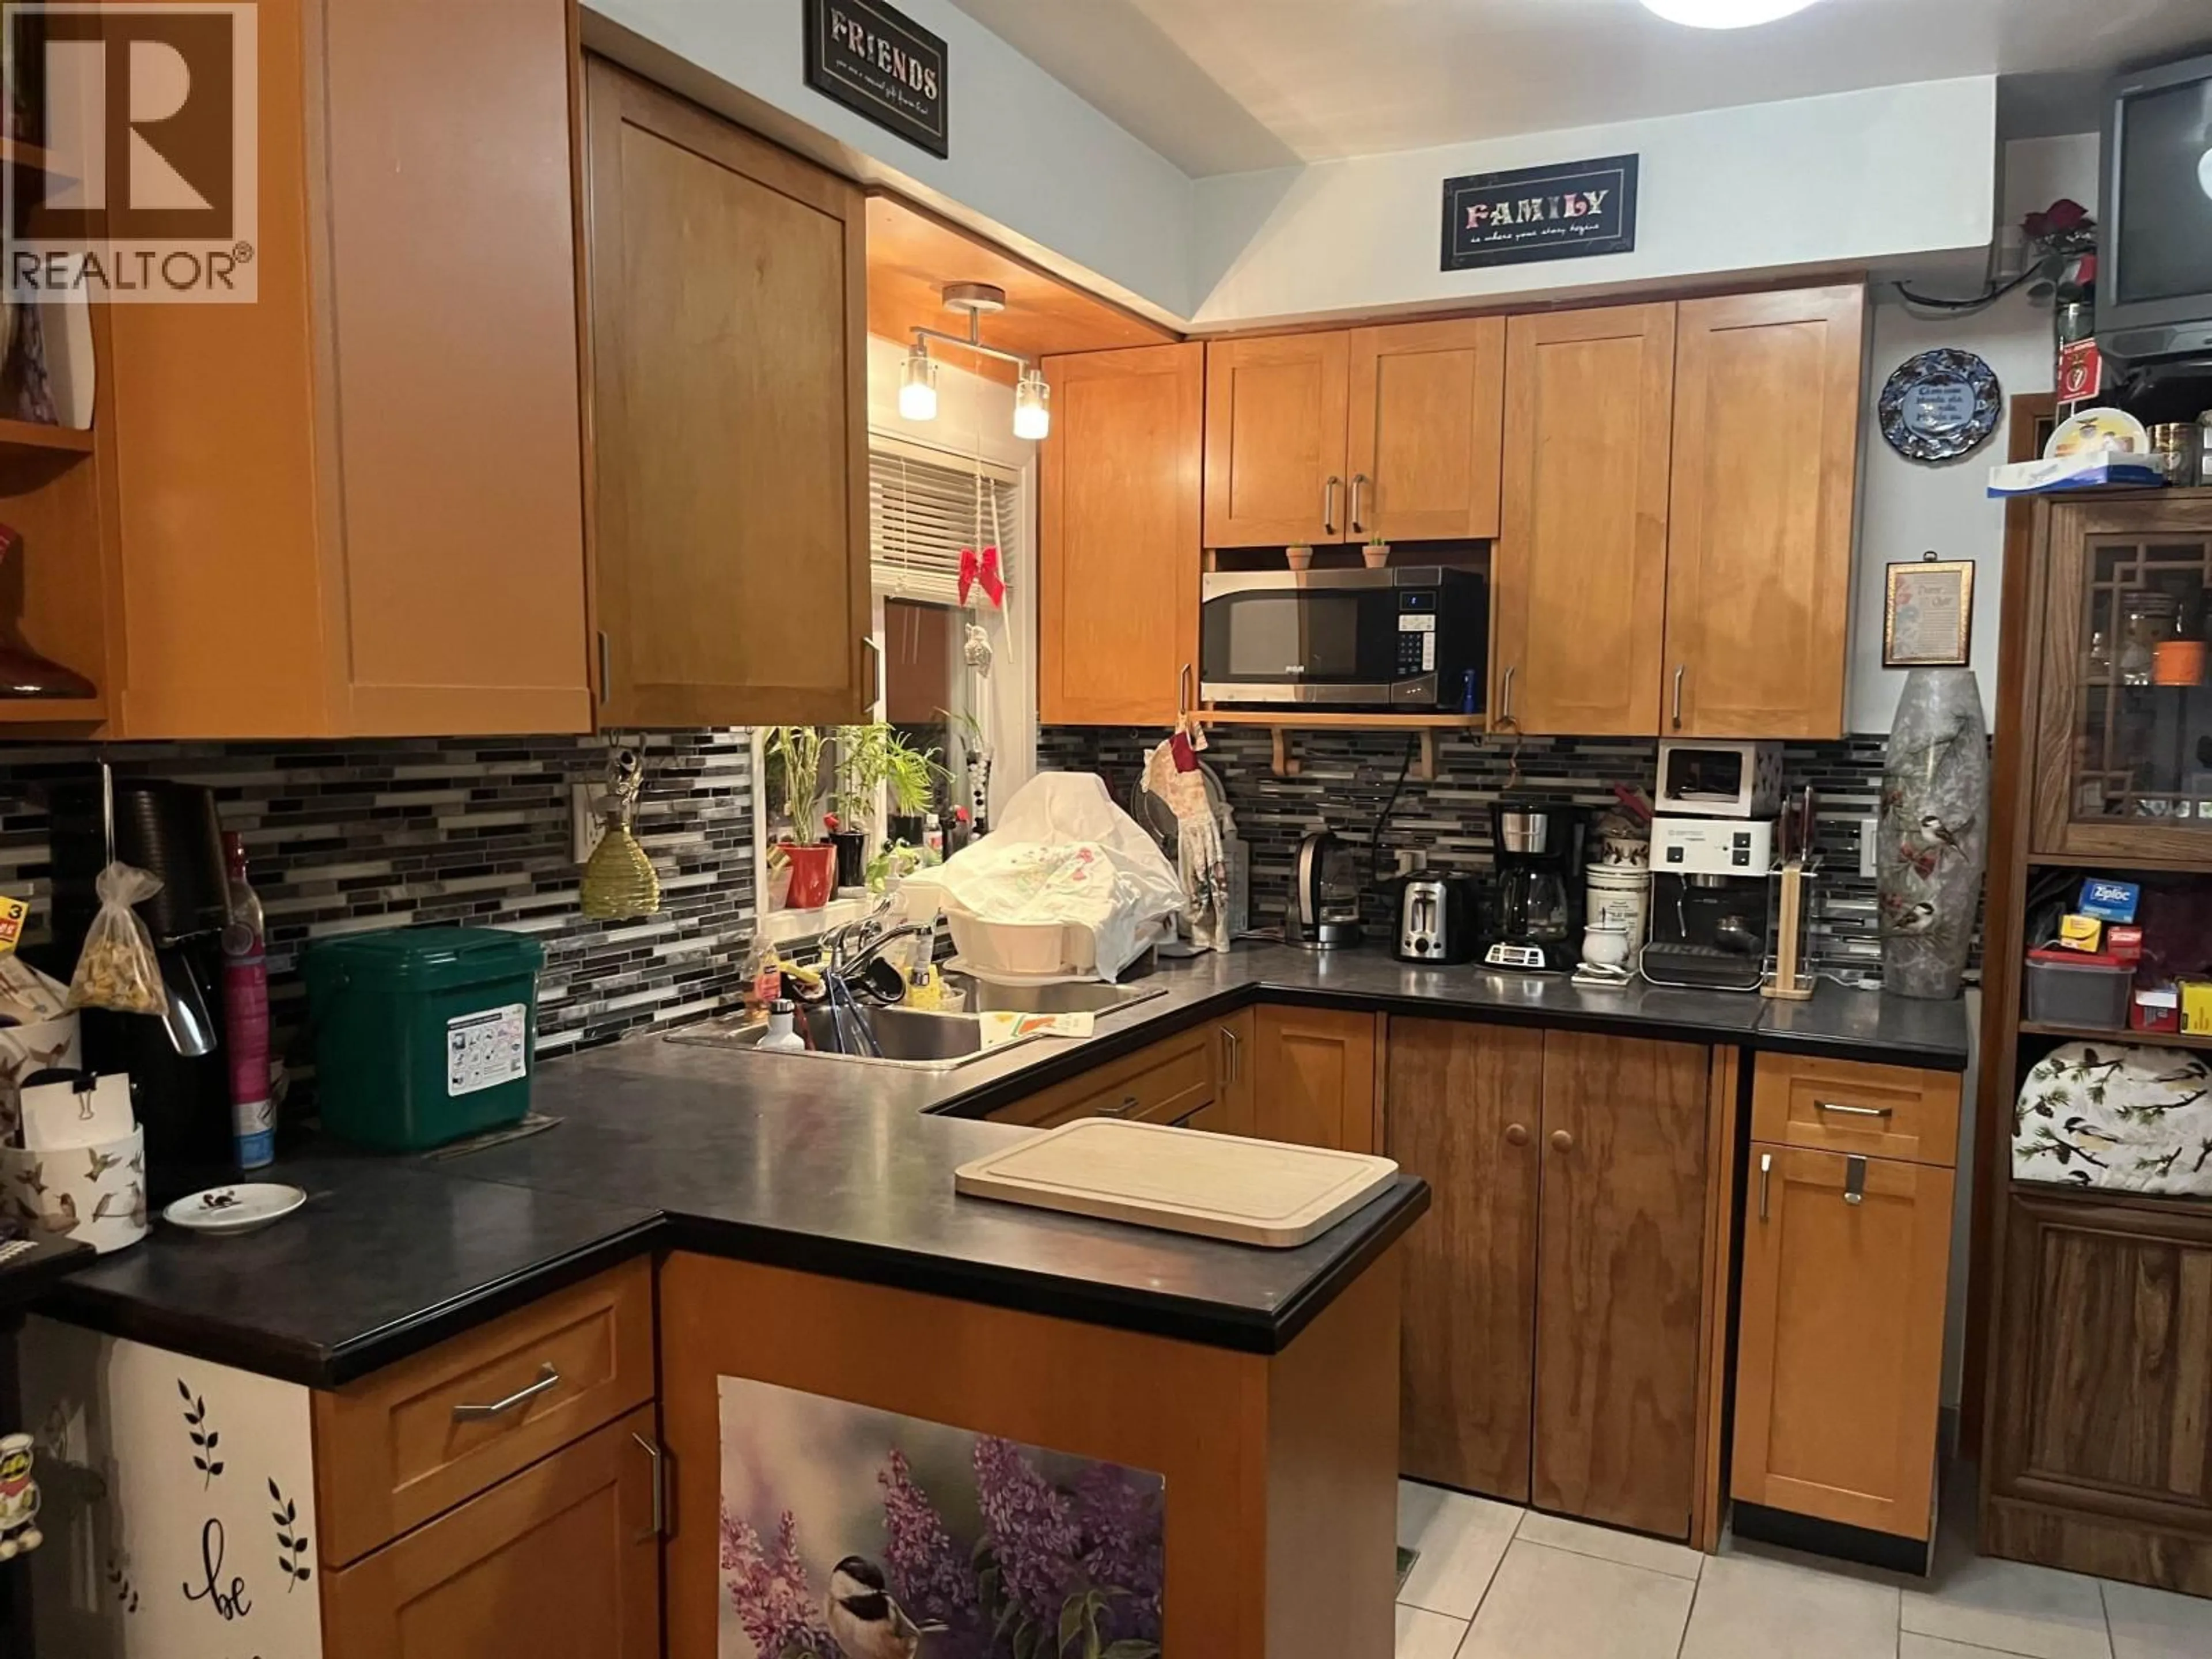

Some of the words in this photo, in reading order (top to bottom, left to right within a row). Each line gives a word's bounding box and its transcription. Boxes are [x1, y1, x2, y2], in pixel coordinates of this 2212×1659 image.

[831, 7, 938, 100] FRIENDS
[1465, 189, 1609, 229] FAMILY
[8, 904, 22, 919] 3
[2094, 885, 2130, 901] Ziploc
[183, 1518, 252, 1620] be
